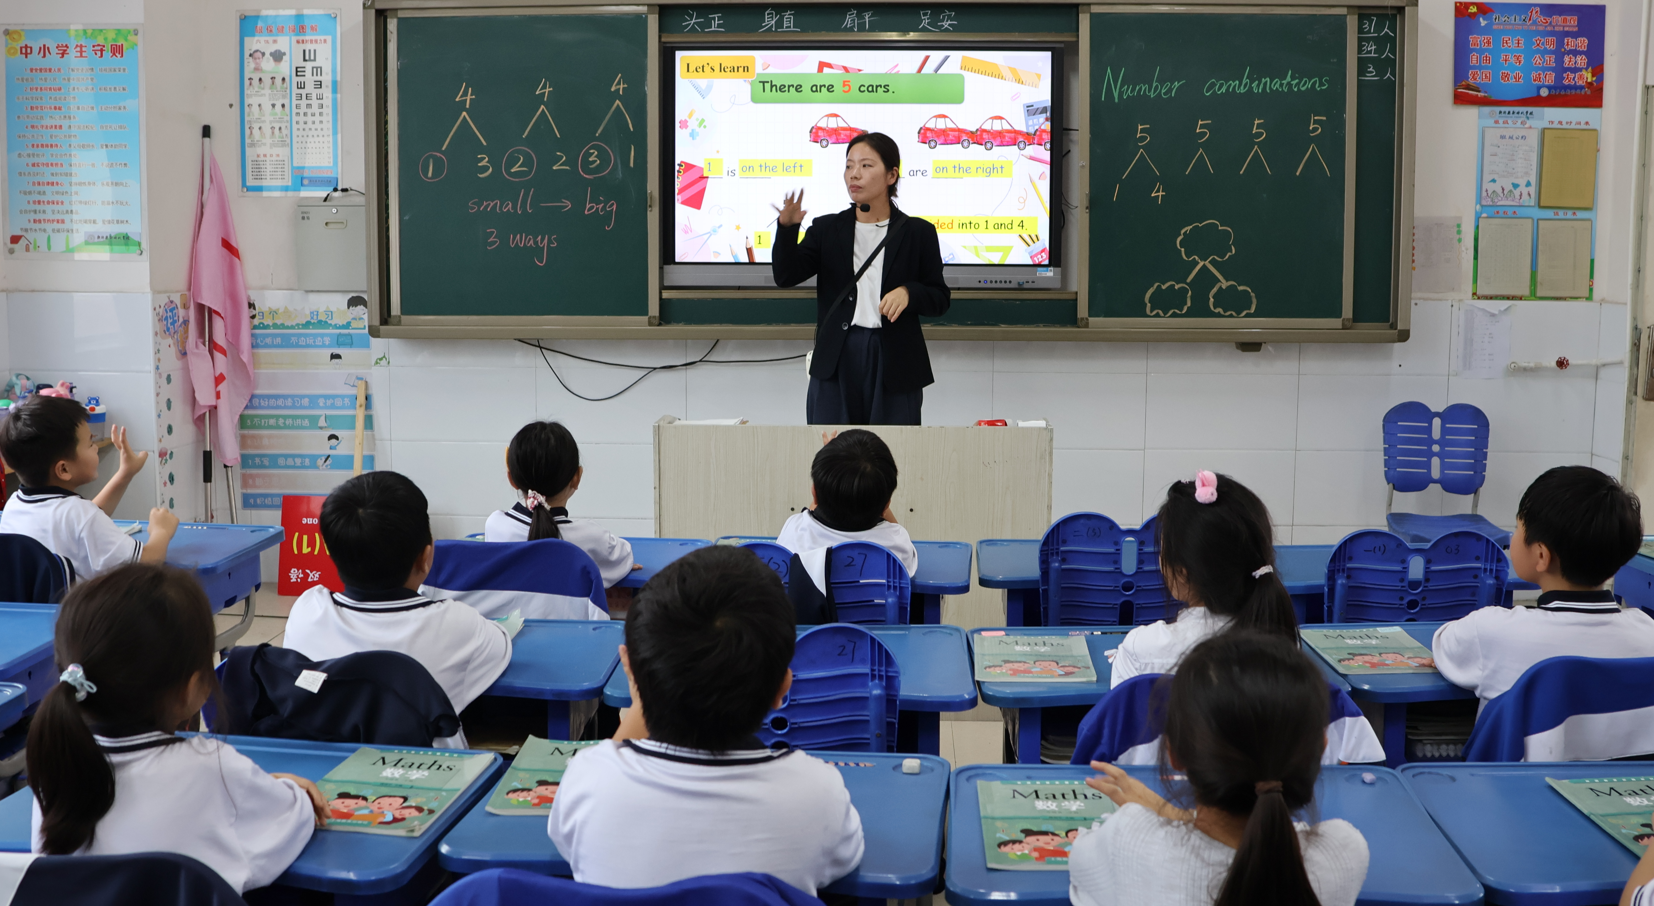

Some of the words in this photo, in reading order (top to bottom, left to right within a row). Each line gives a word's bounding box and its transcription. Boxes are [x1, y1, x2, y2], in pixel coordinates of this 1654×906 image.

[682, 9, 726, 33] 头正
[758, 7, 801, 33] 身直
[841, 9, 880, 32] 肩平
[918, 9, 958, 32] 足安
[19, 43, 125, 59] 中小学生守则
[1469, 35, 1493, 49] 富强
[1501, 36, 1525, 49] 民主
[1532, 37, 1557, 50] 文明
[1564, 37, 1589, 51] 和谐
[719, 63, 750, 74] learn
[1469, 52, 1492, 66] 自由
[1500, 53, 1525, 66] 平等
[1532, 55, 1556, 67] 公正
[1563, 55, 1588, 68] 法治
[611, 73, 628, 95] 4
[758, 80, 804, 94] There
[810, 83, 835, 94] are
[842, 79, 852, 94] 5
[858, 82, 896, 94] cars.
[1101, 65, 1187, 103] Number
[1204, 66, 1330, 96] combinations
[1469, 70, 1492, 83] 爱国
[1500, 71, 1524, 84] 敬业
[1531, 71, 1556, 85] 诚信
[1562, 72, 1588, 86] 友善
[455, 82, 476, 109] 4
[535, 78, 553, 102] 4
[1136, 123, 1151, 146] 5
[1195, 119, 1212, 143] 5
[1252, 118, 1267, 142] 5
[1309, 113, 1327, 136] 5
[477, 154, 493, 178] 3
[510, 153, 528, 173] 2
[552, 151, 571, 171] 2
[588, 149, 600, 168] 3
[630, 144, 635, 168] 1
[707, 161, 712, 172] 1
[727, 166, 736, 177] is
[741, 165, 755, 173] on
[758, 163, 778, 173] the
[782, 162, 804, 173] left
[908, 169, 928, 177] are
[935, 166, 948, 174] on
[952, 164, 972, 174] the
[975, 164, 1005, 177] right
[1113, 183, 1120, 202] 1
[1151, 182, 1166, 204] 4
[468, 188, 534, 214] small
[584, 187, 618, 230] big
[958, 219, 980, 230] into
[985, 219, 989, 230] 1
[993, 219, 1014, 230] and
[1017, 219, 1028, 231] 4.
[486, 228, 500, 250] 3
[509, 232, 558, 266] ways
[757, 234, 762, 245] 1
[1033, 252, 1047, 264] 123
[163, 305, 178, 334] 评
[292, 532, 330, 555] (1)
[289, 568, 322, 583] 双语
[844, 552, 868, 578] 27
[837, 640, 857, 663] 27
[370, 756, 456, 772] Maths
[380, 767, 429, 780] 数学
[1011, 789, 1103, 800] Maths
[1034, 800, 1085, 811] 数学
